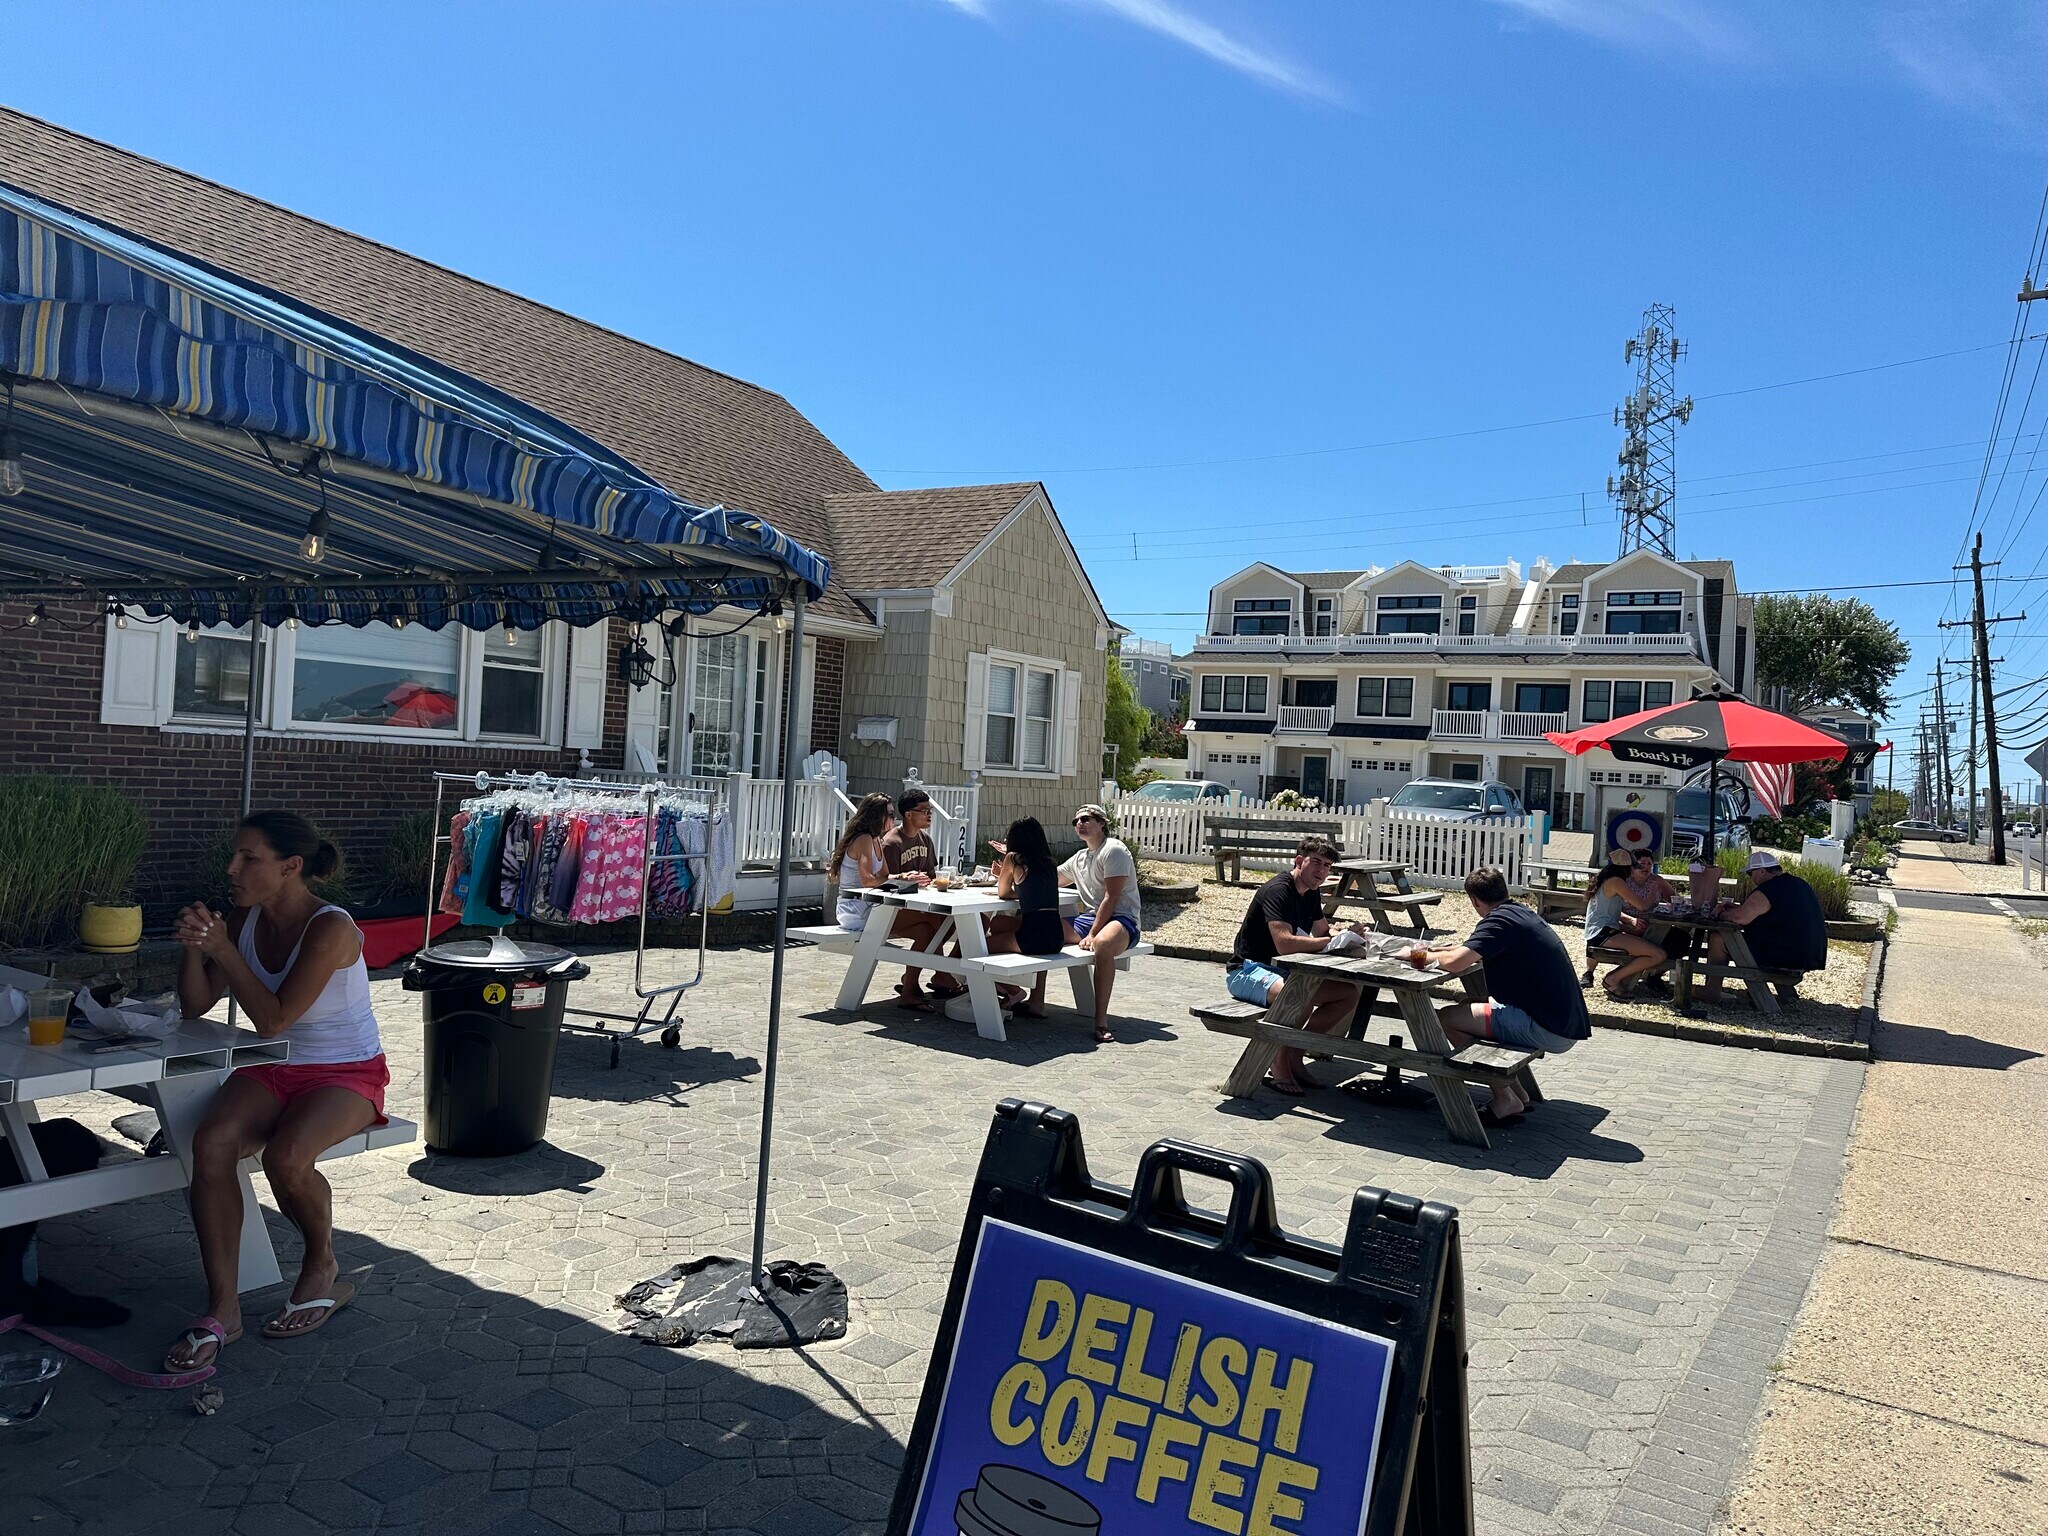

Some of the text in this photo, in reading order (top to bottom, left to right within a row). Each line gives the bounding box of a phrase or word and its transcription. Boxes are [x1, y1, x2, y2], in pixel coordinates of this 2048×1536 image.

[1627, 747, 1694, 766] Boar's He
[901, 846, 928, 866] BOSTON
[958, 826, 966, 876] 260
[488, 992, 499, 1002] A
[1018, 1279, 1314, 1454] DELISH
[990, 1361, 1319, 1536] COFFEE
